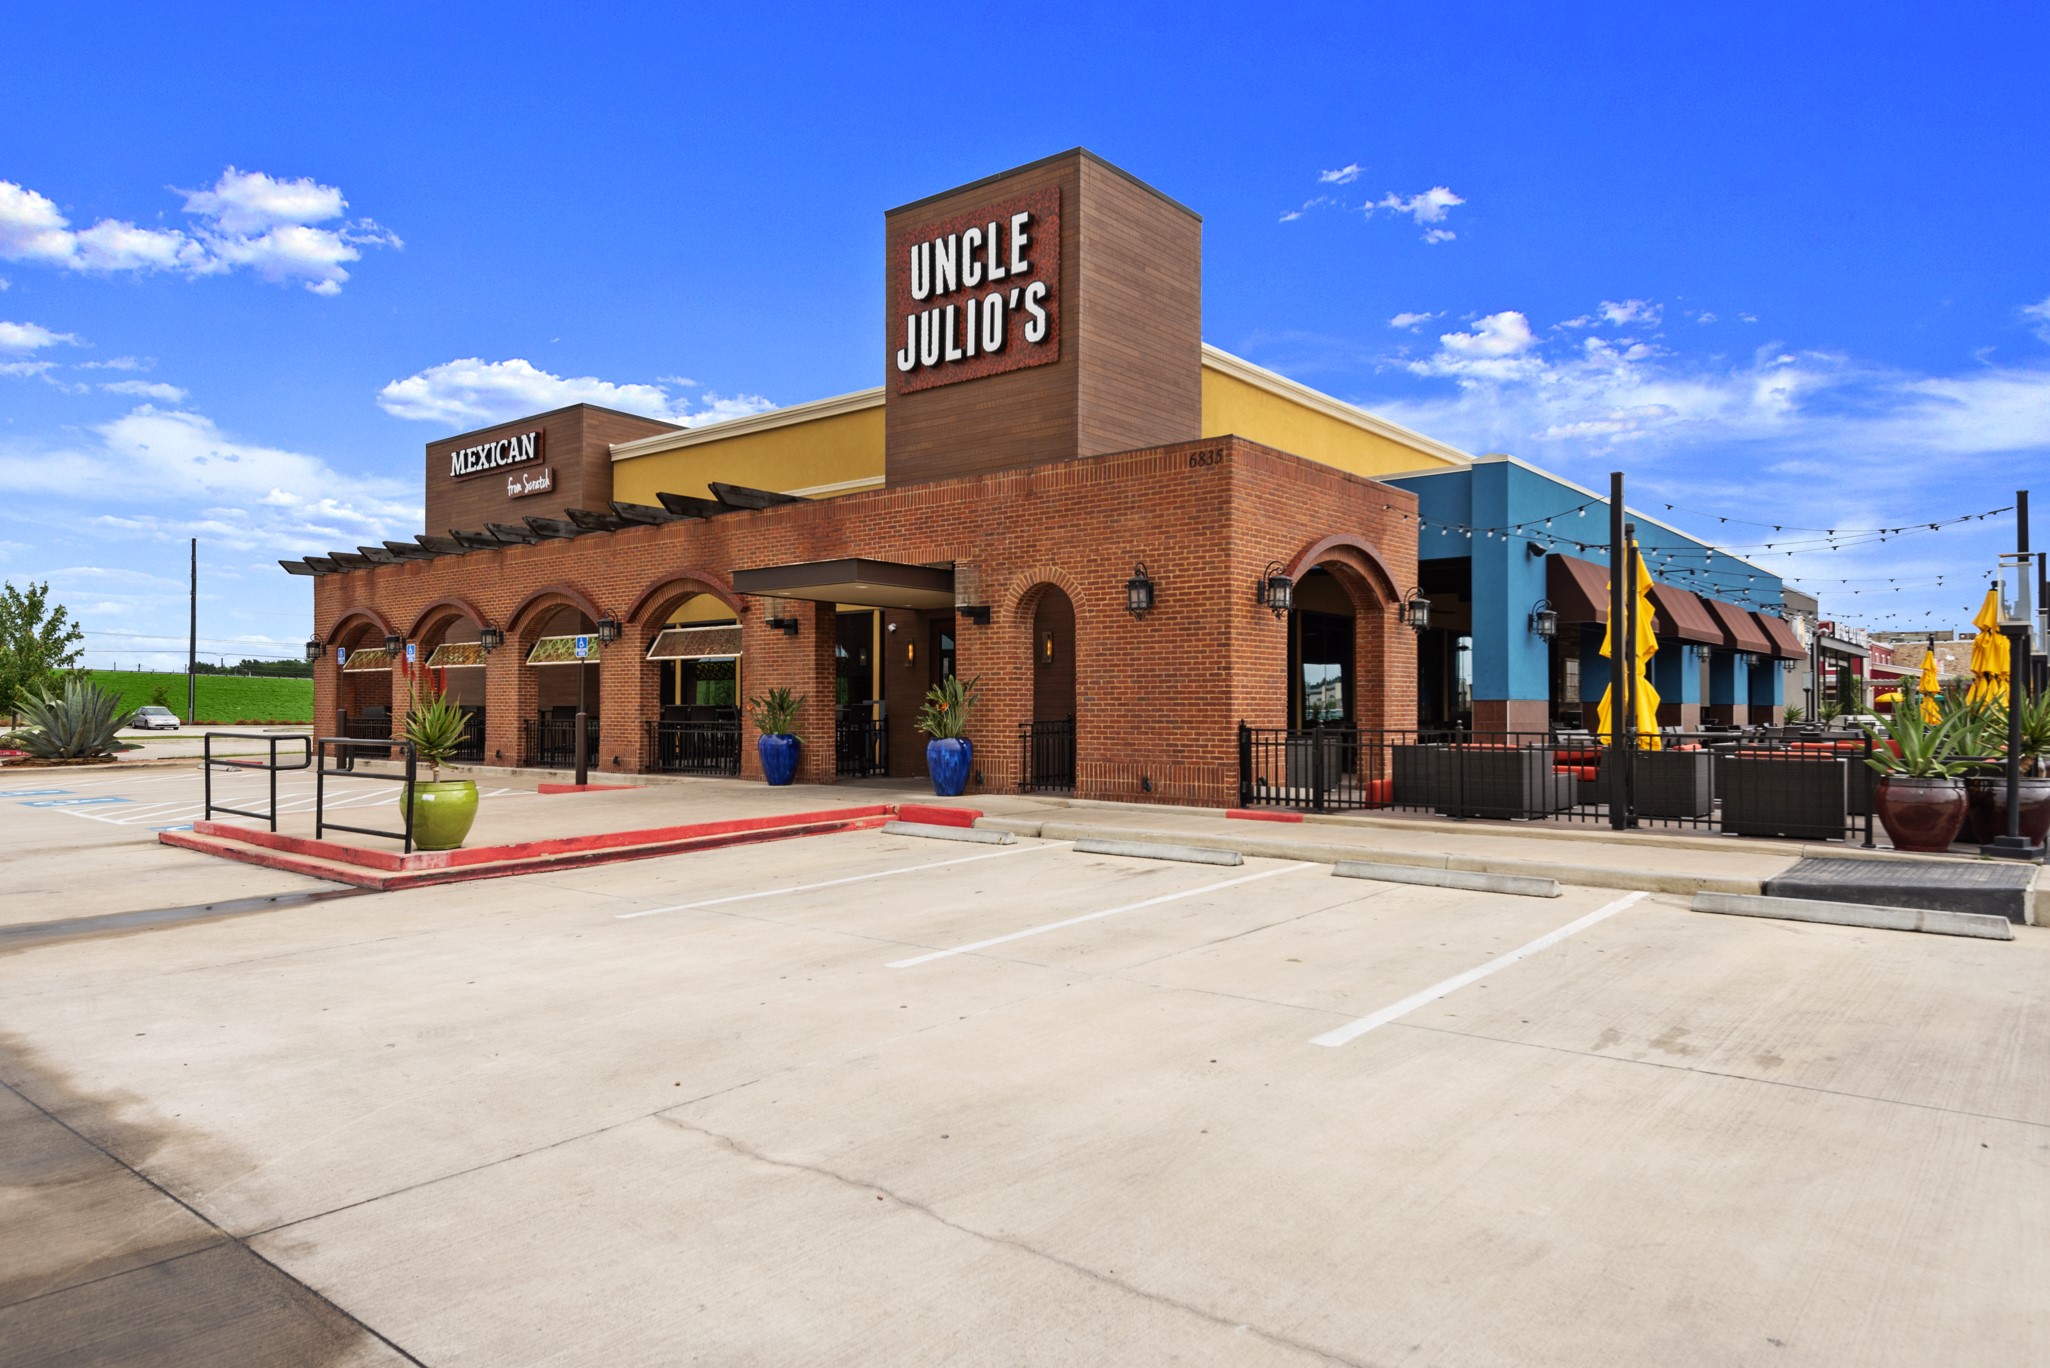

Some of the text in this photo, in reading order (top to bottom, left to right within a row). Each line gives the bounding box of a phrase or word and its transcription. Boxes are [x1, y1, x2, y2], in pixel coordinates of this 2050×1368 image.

[911, 211, 1029, 300] UNCLE
[897, 281, 1047, 372] JULIO'S
[450, 432, 536, 477] MEXICAN
[1189, 448, 1224, 468] 6835
[507, 468, 550, 496] from Scratch
